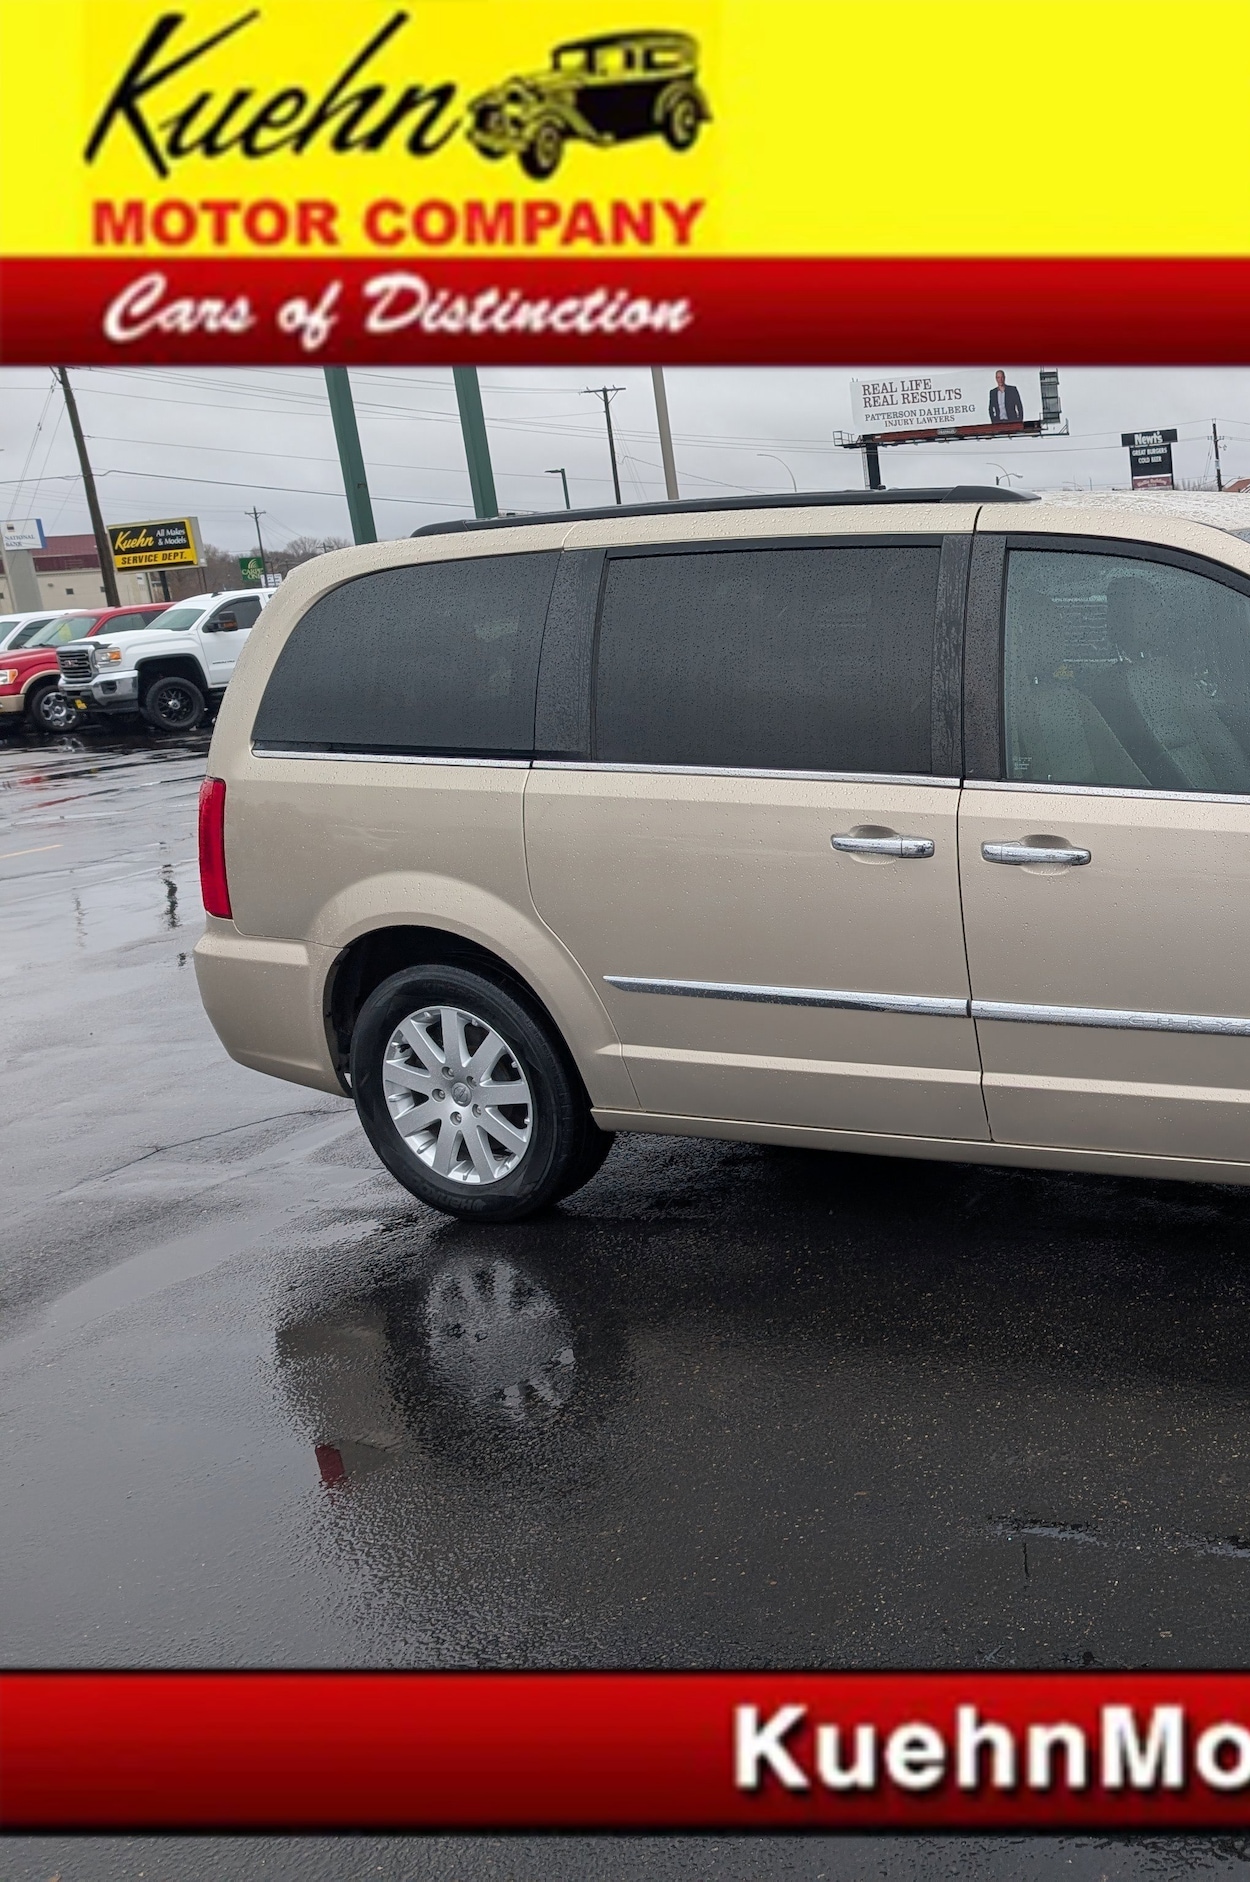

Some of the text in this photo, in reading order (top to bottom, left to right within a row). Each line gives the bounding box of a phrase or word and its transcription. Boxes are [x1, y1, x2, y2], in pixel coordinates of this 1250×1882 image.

[862, 378, 932, 396] REAL LIFE
[863, 388, 962, 408] REAL RESULTS
[865, 405, 976, 421] PATTERSON DAHLBERG
[885, 415, 955, 427] INJURY LAWYERS
[1134, 431, 1163, 446] Newt's
[1147, 447, 1168, 455] BURGERS
[114, 529, 154, 552] Kuehn
[166, 527, 185, 536] Makes
[157, 537, 187, 546] & Models
[121, 551, 187, 565] SERVICE DEPT.
